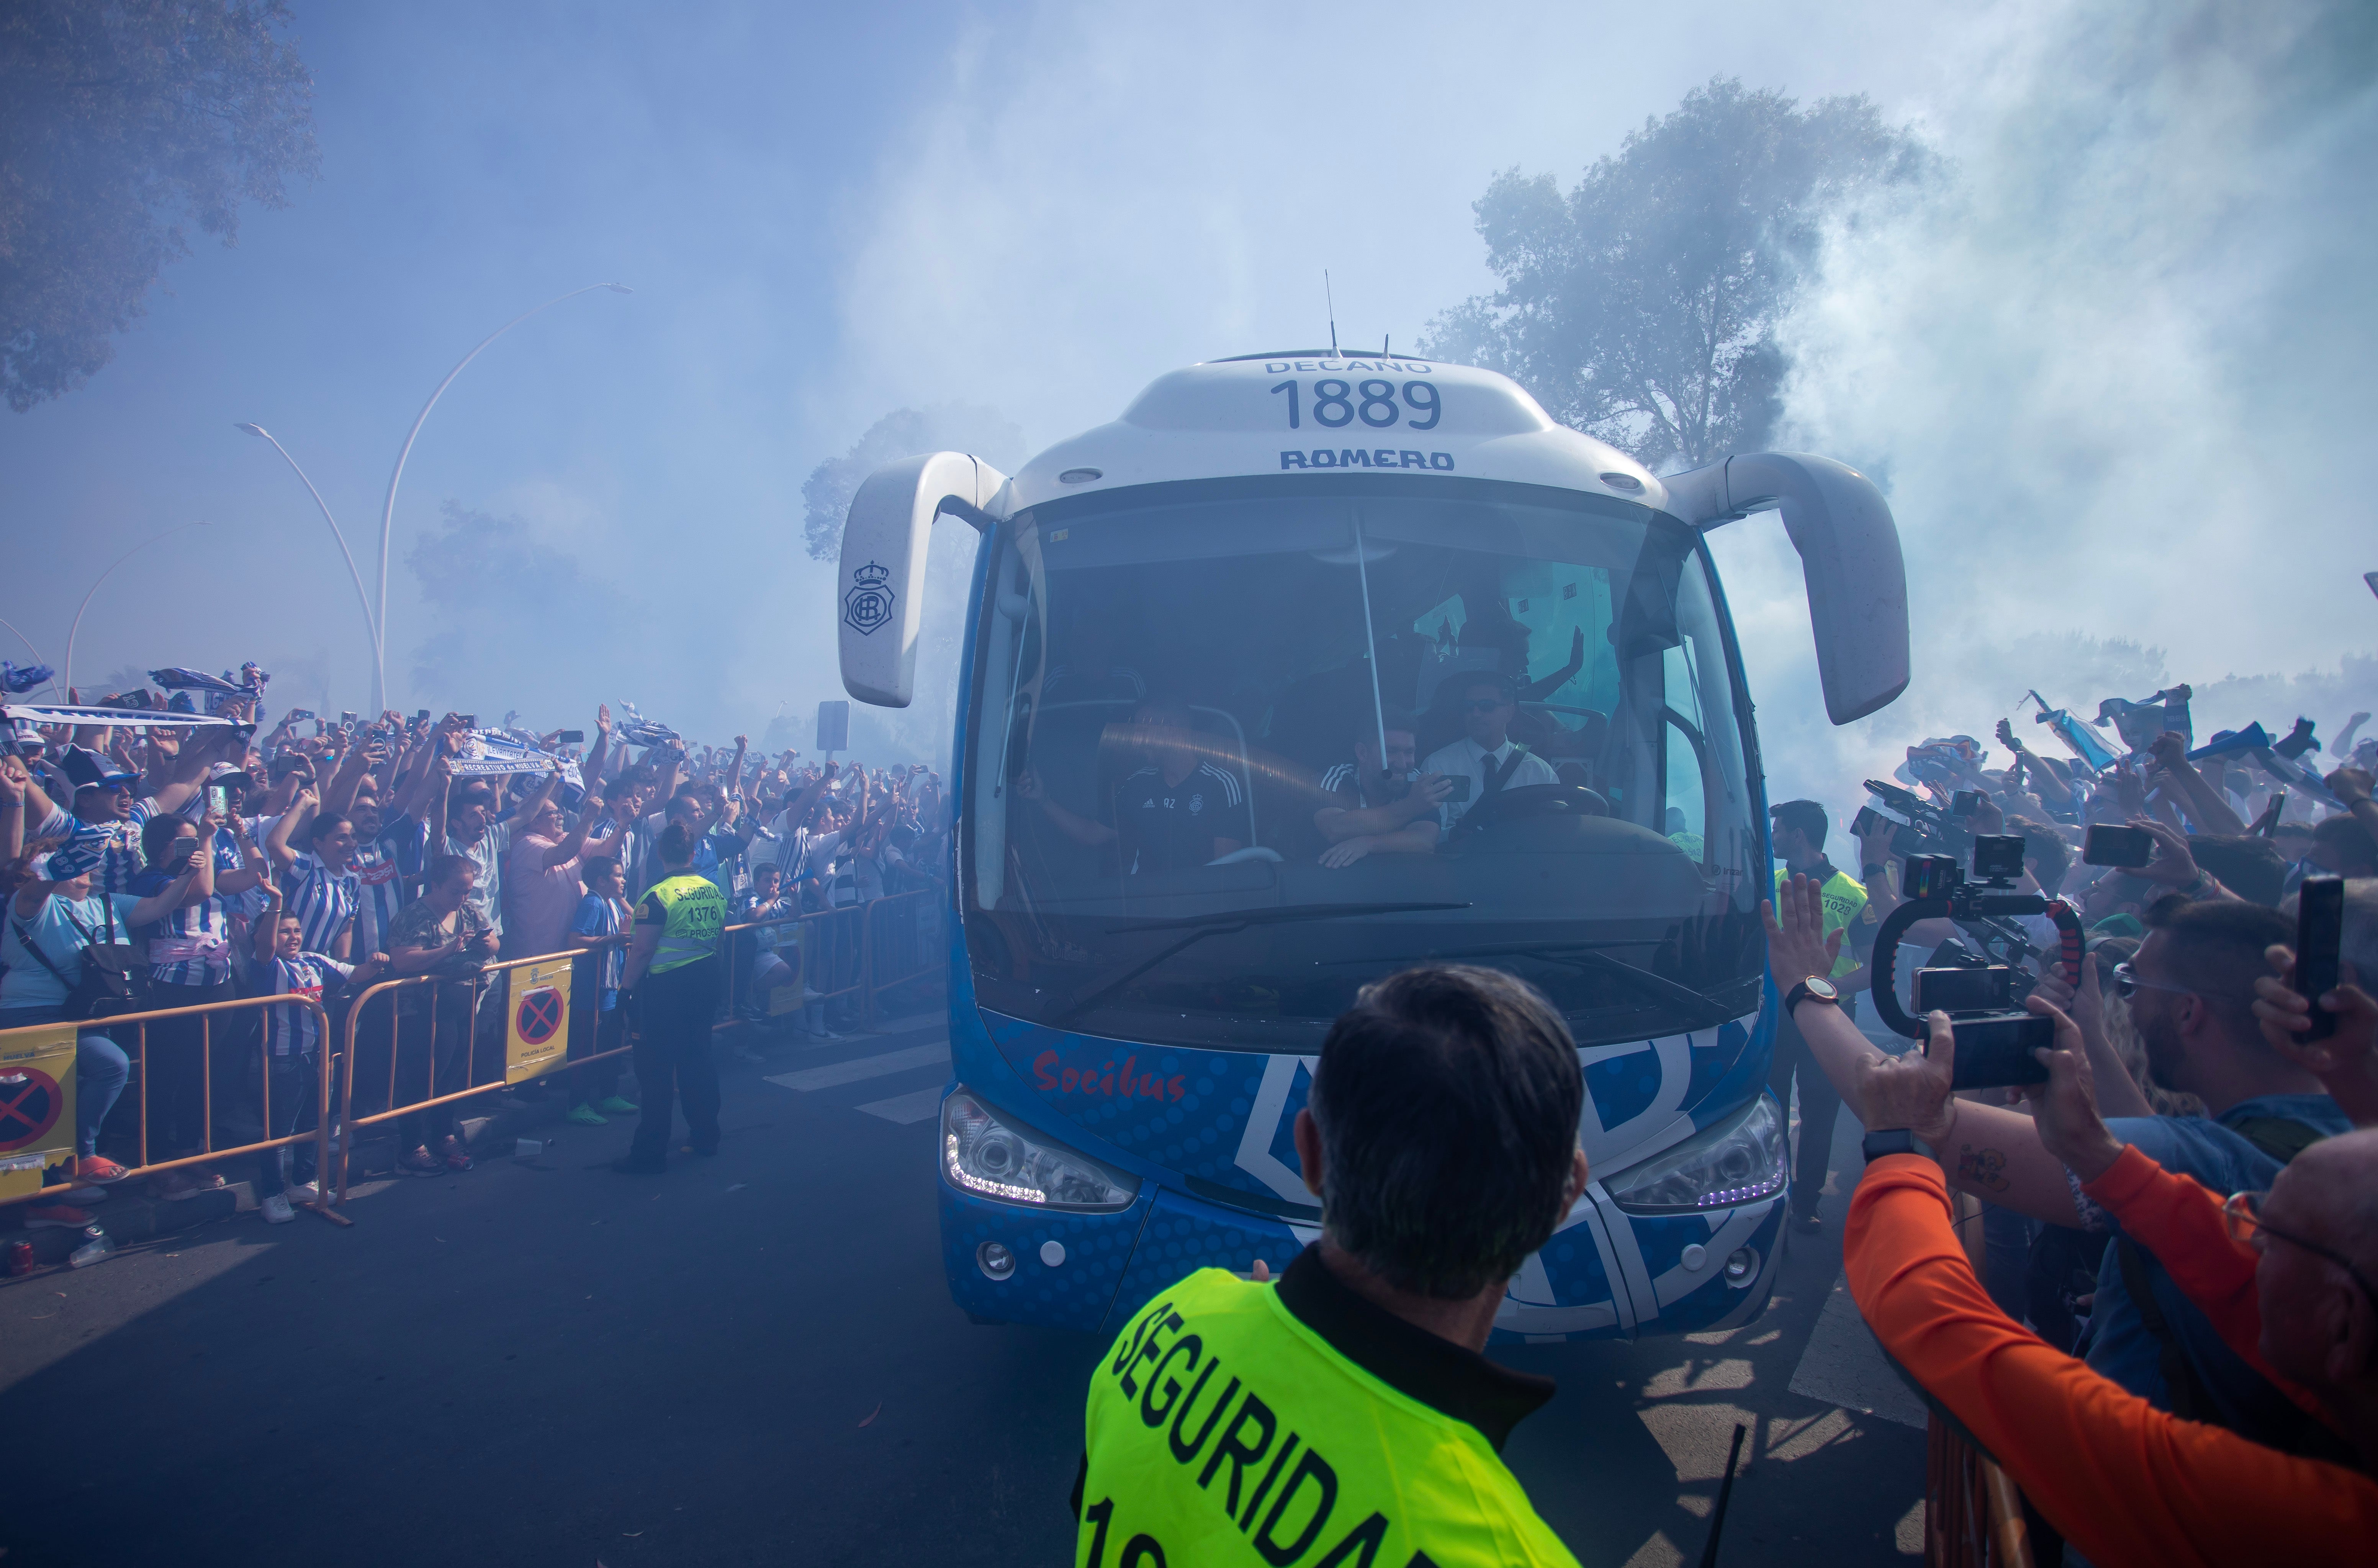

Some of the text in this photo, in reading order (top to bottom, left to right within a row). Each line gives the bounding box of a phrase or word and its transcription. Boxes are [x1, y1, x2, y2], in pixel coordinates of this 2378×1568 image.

[1265, 360, 1432, 374] DECANO
[1270, 379, 1441, 430] 1889
[1280, 449, 1455, 471] ROMERO
[122, 695, 139, 708] 13
[465, 763, 506, 771] RECREATIVO
[517, 762, 541, 770] HUELVA
[1164, 798, 1175, 809] AZ
[1822, 892, 1858, 907] SEGURIDAD
[688, 906, 717, 922] 1376
[1824, 899, 1851, 915] 1028
[690, 927, 721, 938] PROSEG
[3, 1051, 35, 1060] HUELVA
[540, 1045, 555, 1053] LOCAL
[1033, 1049, 1186, 1103] Socibus
[1112, 1302, 1443, 1568] SEGURIDA
